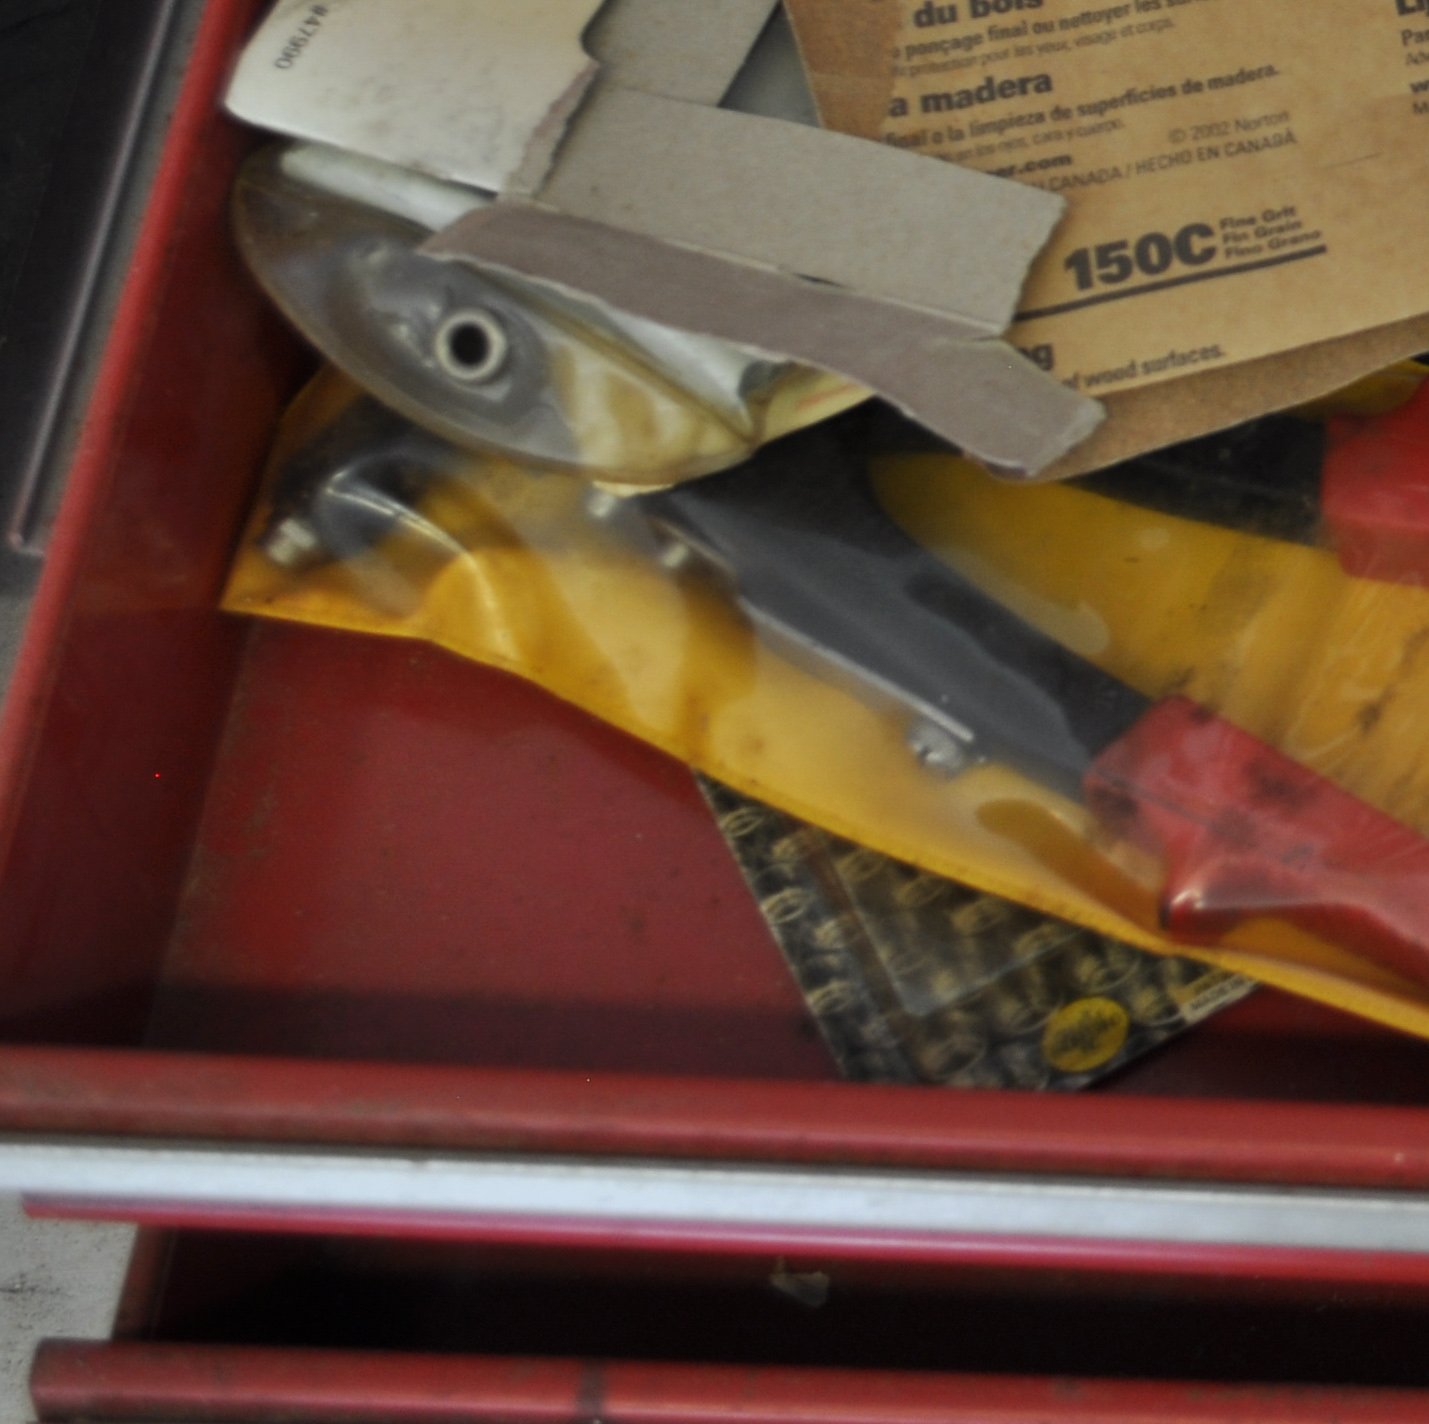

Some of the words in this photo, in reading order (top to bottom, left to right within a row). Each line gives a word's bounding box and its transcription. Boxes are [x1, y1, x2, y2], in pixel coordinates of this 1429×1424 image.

[913, 0, 958, 29] du
[920, 73, 1054, 114] madera
[1050, 105, 1073, 121] de
[1181, 76, 1204, 95] de
[1219, 215, 1256, 229] Fine
[1064, 222, 1217, 291] 150C
